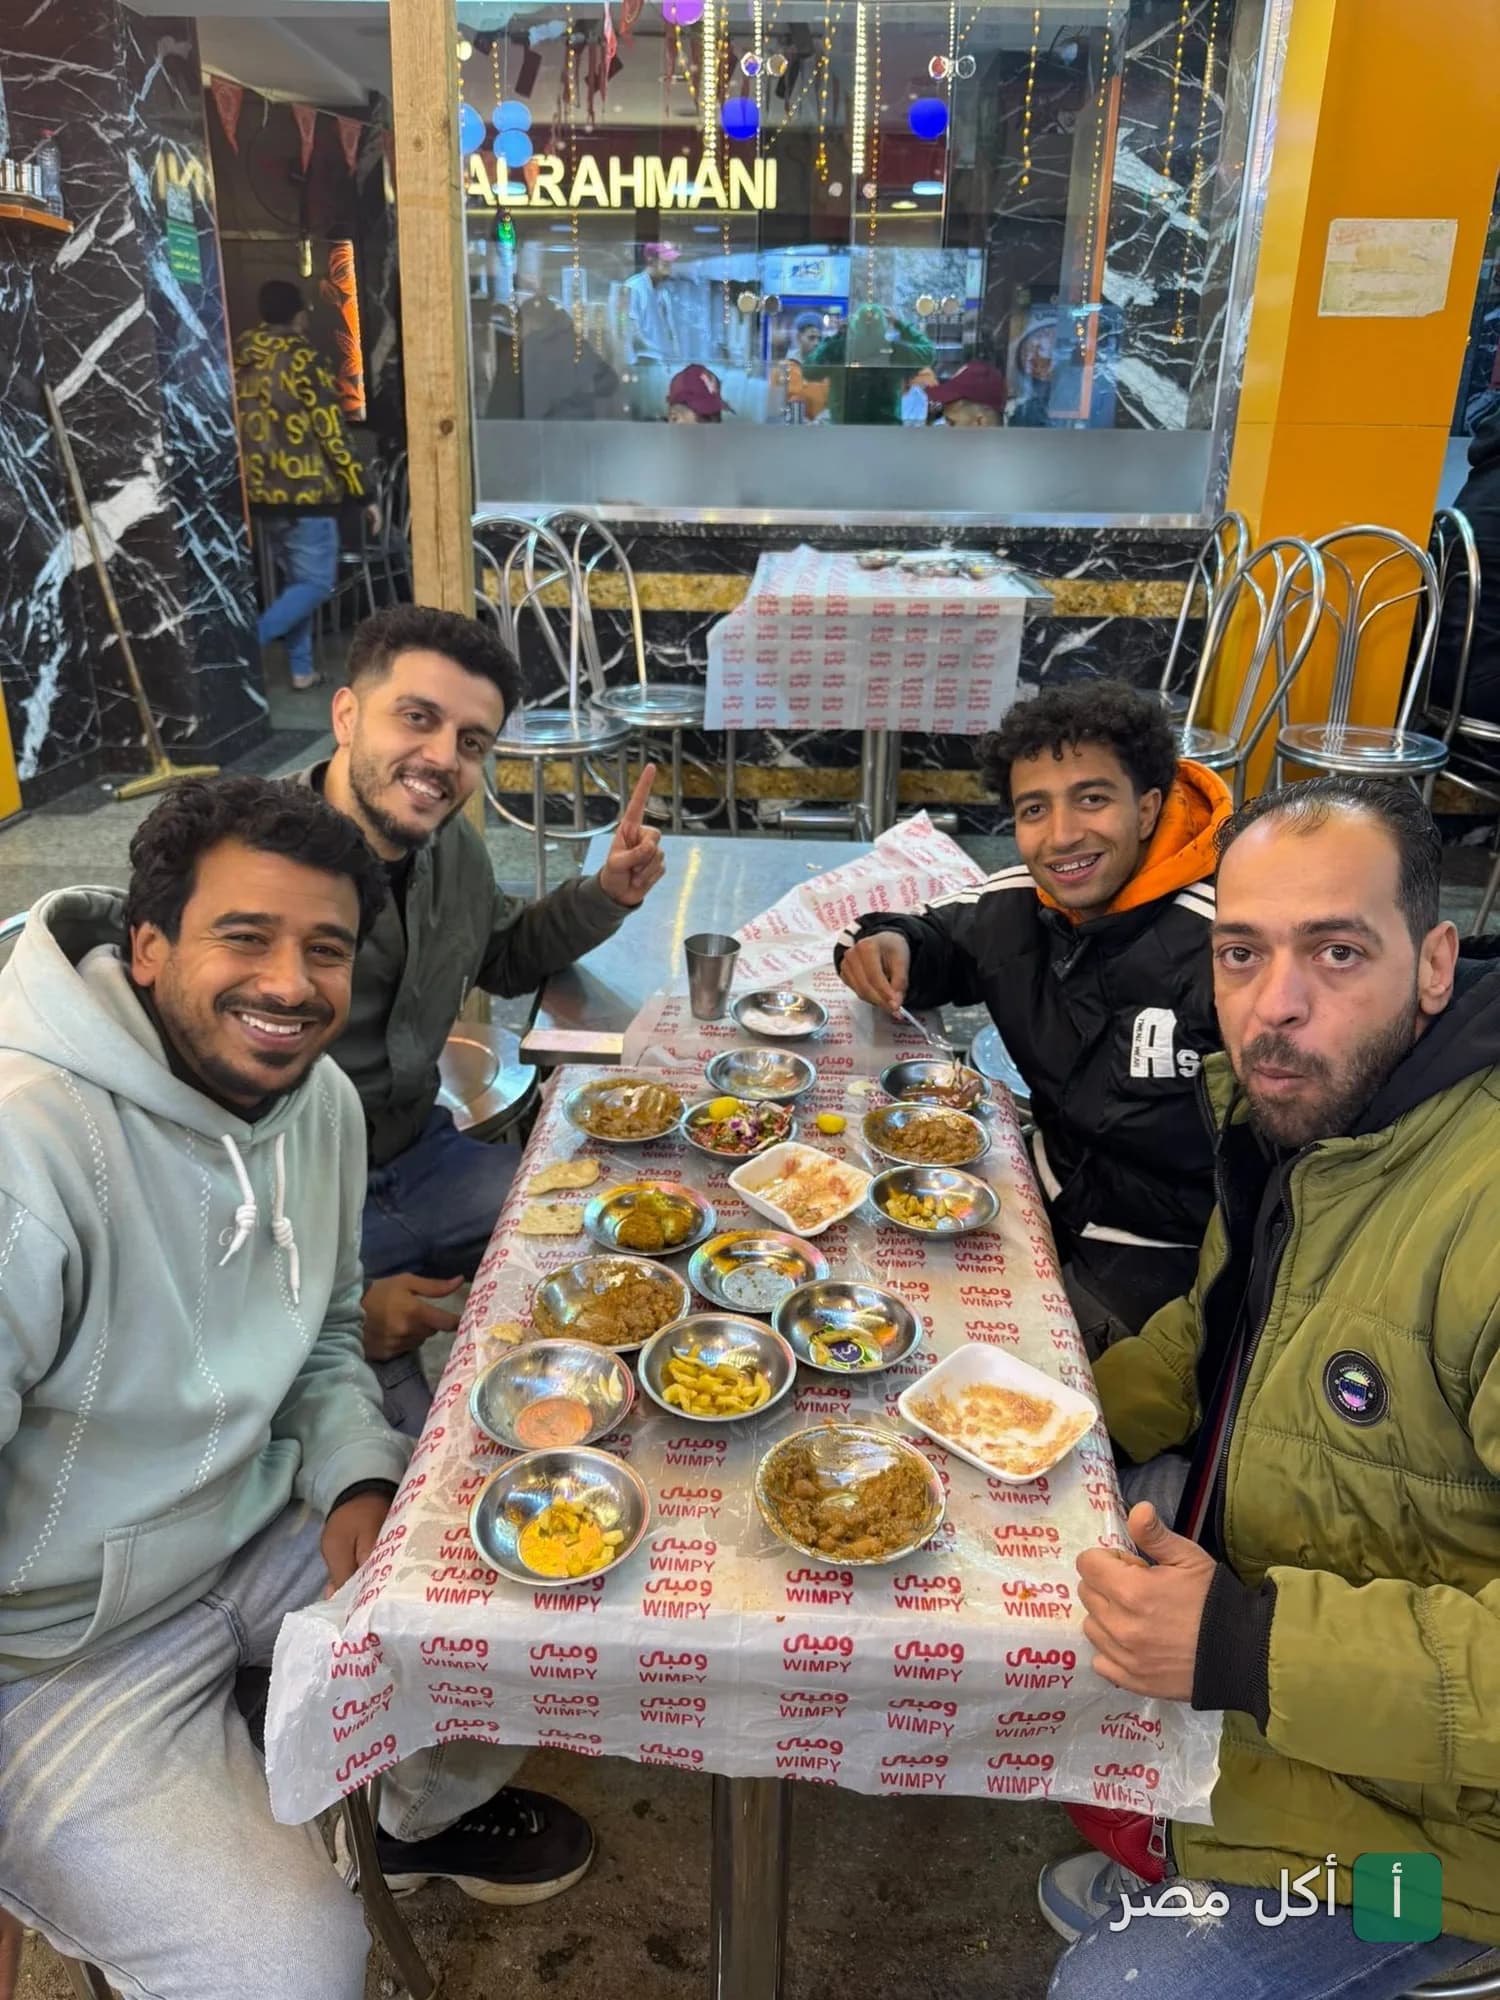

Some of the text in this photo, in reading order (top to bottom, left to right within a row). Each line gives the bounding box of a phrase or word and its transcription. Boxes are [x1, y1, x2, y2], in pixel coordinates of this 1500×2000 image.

[466, 154, 778, 210] ALRAHMANI
[876, 1248, 926, 1259] ومبى
[954, 1241, 1002, 1251] WIMPY
[955, 1253, 1005, 1264] ومبى
[956, 1264, 1006, 1275] WIMPY
[960, 1286, 1012, 1298] ومبى
[961, 1297, 1013, 1309] WIMPY
[966, 1321, 1019, 1334] ومبى
[794, 1401, 848, 1414] WIMPY
[664, 1437, 726, 1452] ومبى
[666, 1453, 727, 1468] WIMPY
[657, 1485, 725, 1502] ومبى
[986, 1490, 1051, 1505] WIMPY
[655, 1504, 723, 1519] WIMPY
[991, 1524, 1060, 1542] ومبى
[439, 1546, 483, 1561] WIM
[652, 1536, 720, 1556] ومبى
[995, 1544, 1062, 1559] WIMPY
[651, 1556, 719, 1574] WIMPY
[428, 1565, 499, 1586] ومبى
[782, 1568, 853, 1587] ومبى
[644, 1577, 716, 1598] ومبى
[894, 1575, 964, 1594] ومبى
[1002, 1577, 1070, 1599] ومبى
[425, 1587, 491, 1604] WIMPY
[533, 1592, 602, 1614] WIMPY
[785, 1587, 855, 1606] WIMPY
[896, 1595, 964, 1612] WIMPY
[641, 1599, 714, 1619] WIMPY
[1003, 1601, 1076, 1620] WIMPY
[419, 1636, 489, 1658] ومبى
[529, 1643, 598, 1664] ومبى
[783, 1633, 854, 1657] ومبى
[894, 1641, 964, 1664] ومبى
[331, 1651, 384, 1679] WIMPY
[421, 1657, 489, 1672] WIMPY
[639, 1650, 708, 1671] ومبى
[783, 1658, 852, 1674] WIMPY
[1006, 1647, 1077, 1670] ومبى
[529, 1665, 598, 1680] WIMPY
[639, 1671, 708, 1684] WIMPY
[893, 1664, 960, 1682] WIMPY
[428, 1681, 494, 1699] ومبى
[1004, 1673, 1075, 1690] WIMPY
[430, 1693, 495, 1709] WIMPY
[533, 1694, 600, 1707] ومبى
[640, 1696, 706, 1712] ومبى
[781, 1692, 848, 1705] ومبى
[888, 1697, 958, 1717] ومبى
[535, 1706, 600, 1718] WIMPY
[640, 1710, 706, 1729] WIMPY
[778, 1704, 844, 1718] WIMPY
[998, 1709, 1066, 1726] ومبى
[435, 1718, 500, 1732] ومبى
[887, 1713, 956, 1738] WIMPY
[995, 1725, 1062, 1738] WIMPY
[538, 1728, 602, 1744] ومبى
[640, 1743, 704, 1764] ومبى
[776, 1737, 844, 1755] ومبى
[336, 1734, 397, 1783] ومبى
[776, 1756, 842, 1773] WIMPY
[881, 1755, 949, 1768] ومبى
[988, 1752, 1055, 1771] ومبى
[880, 1773, 944, 1789] WIMPY
[1094, 1762, 1160, 1790] ومبى
[987, 1775, 1053, 1796] WIMPY
[1093, 1781, 1156, 1813] WIMPY
